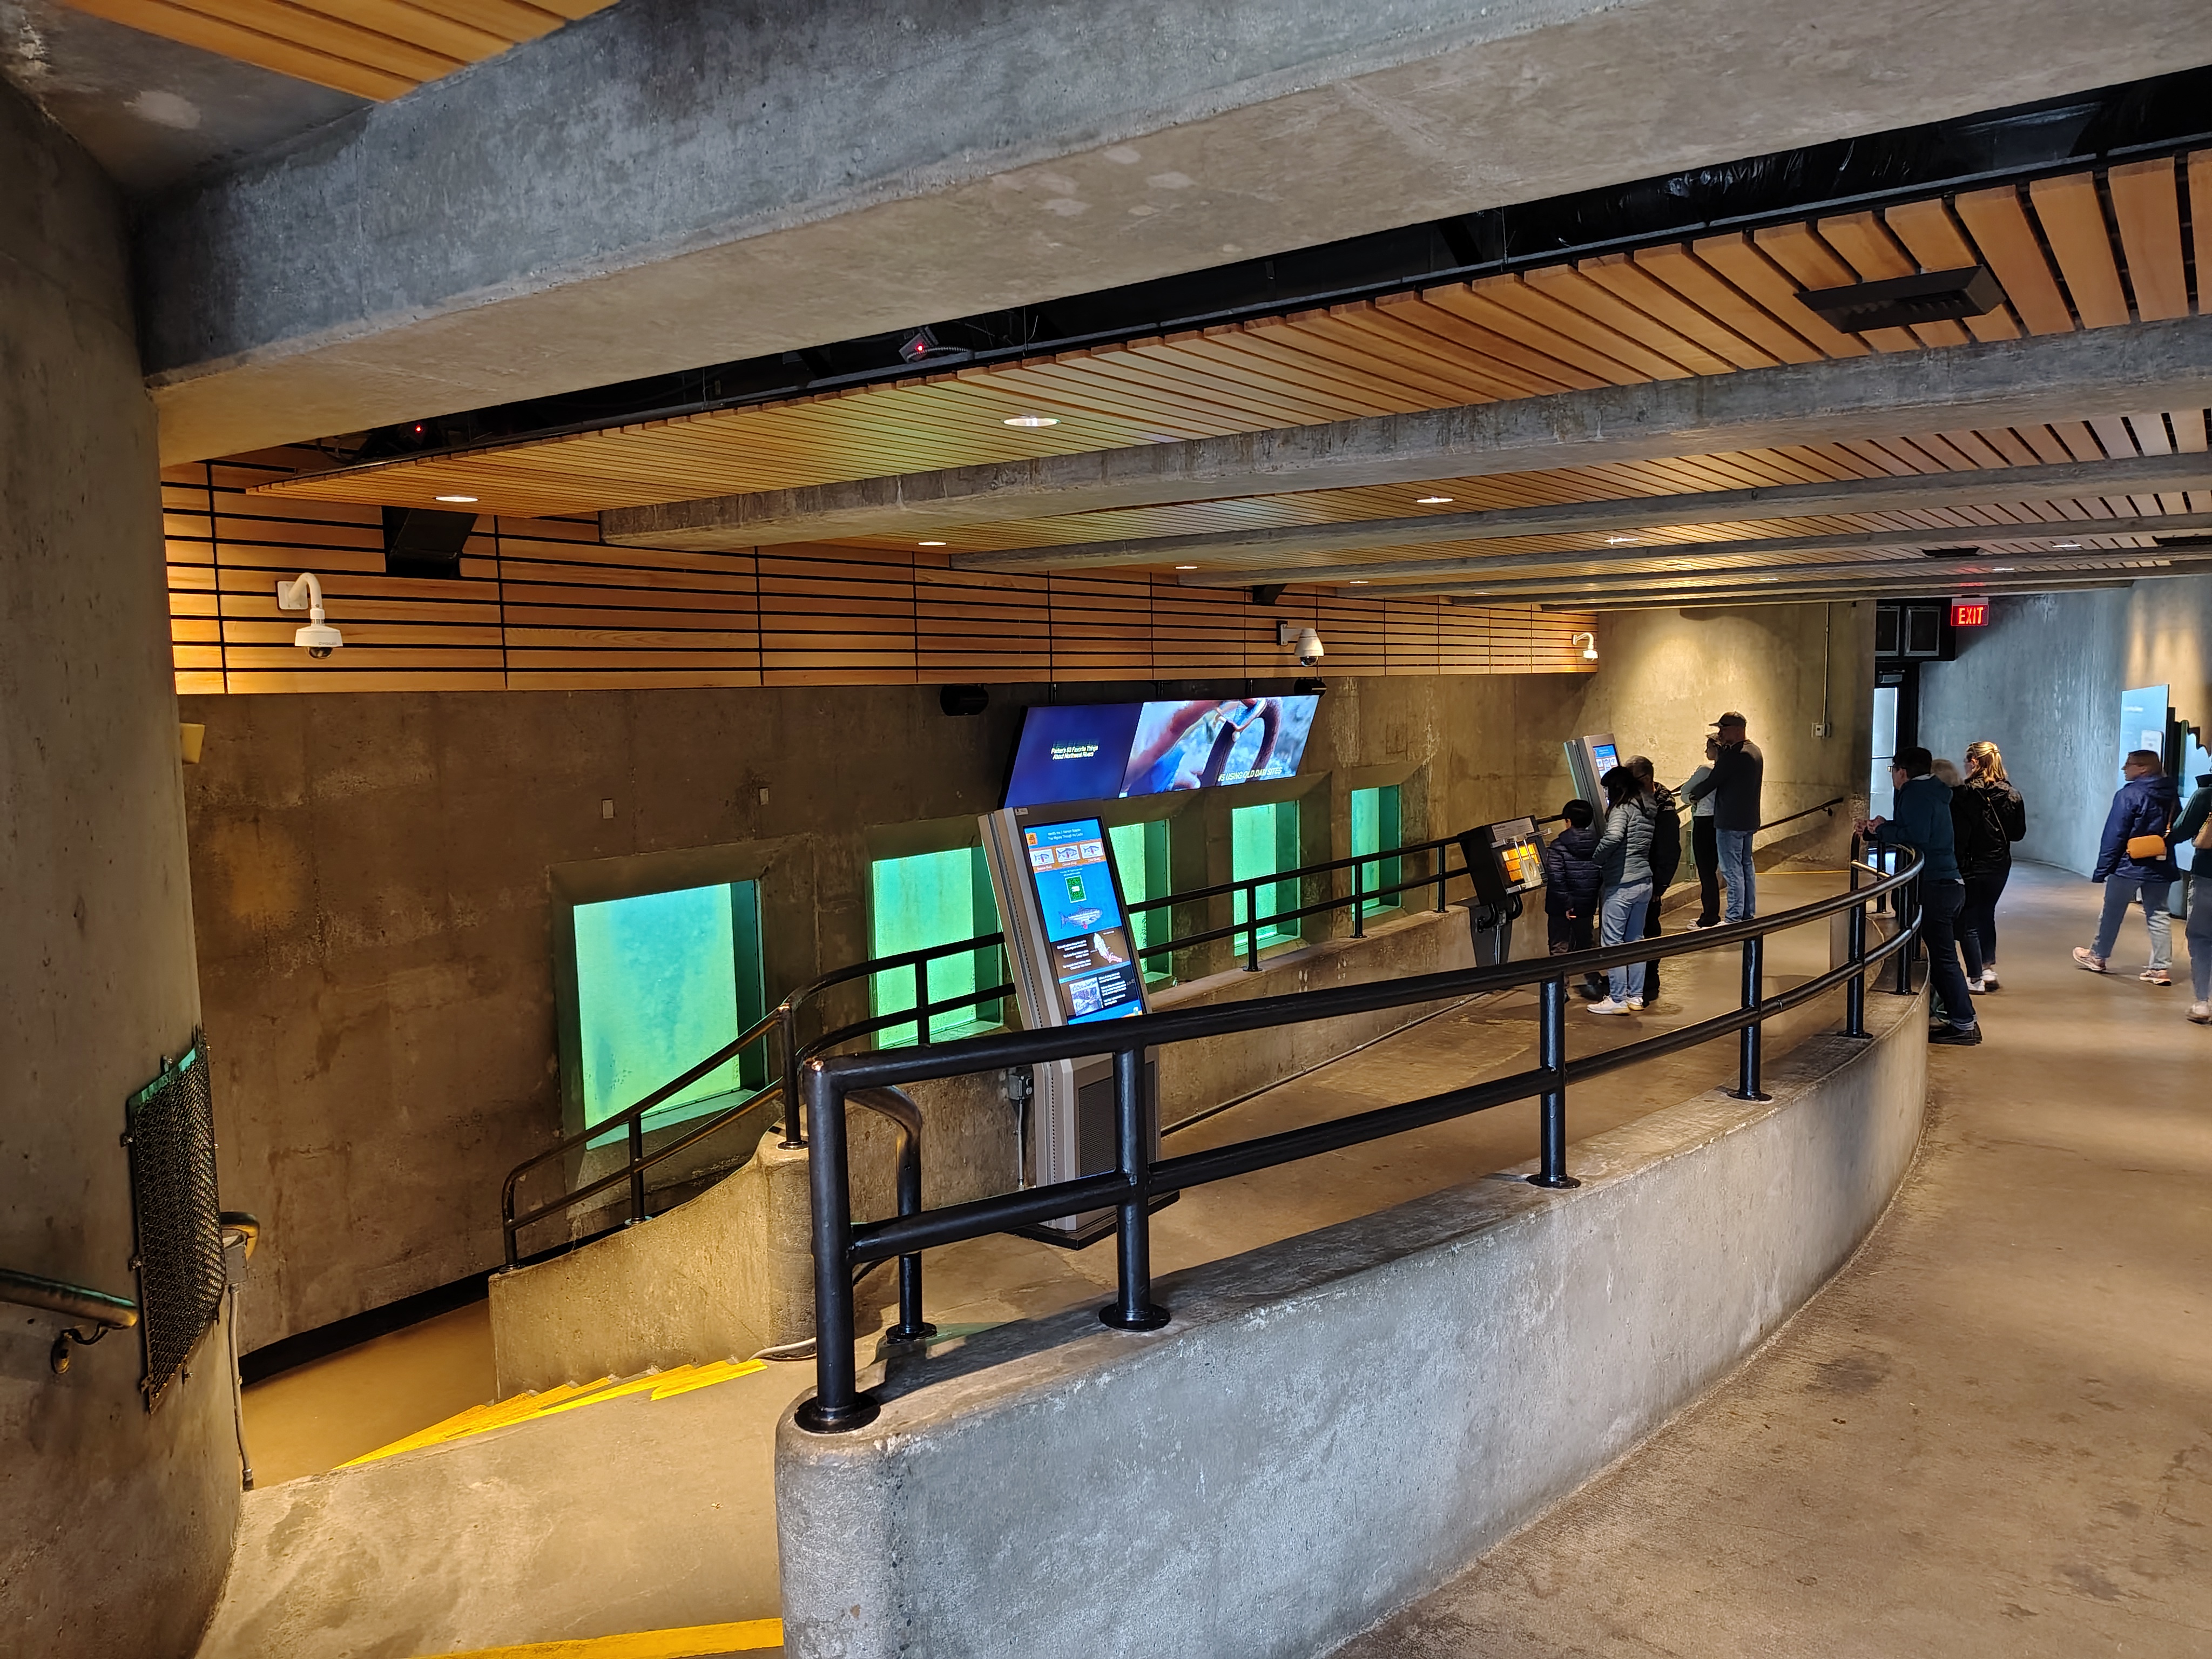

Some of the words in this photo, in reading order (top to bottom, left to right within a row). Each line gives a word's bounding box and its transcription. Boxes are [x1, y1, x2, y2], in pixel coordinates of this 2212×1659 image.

[1958, 607, 1984, 624] EXIT
[1226, 772, 1243, 780] USING
[1243, 770, 1255, 778] OLD
[1267, 767, 1283, 775] SITES
